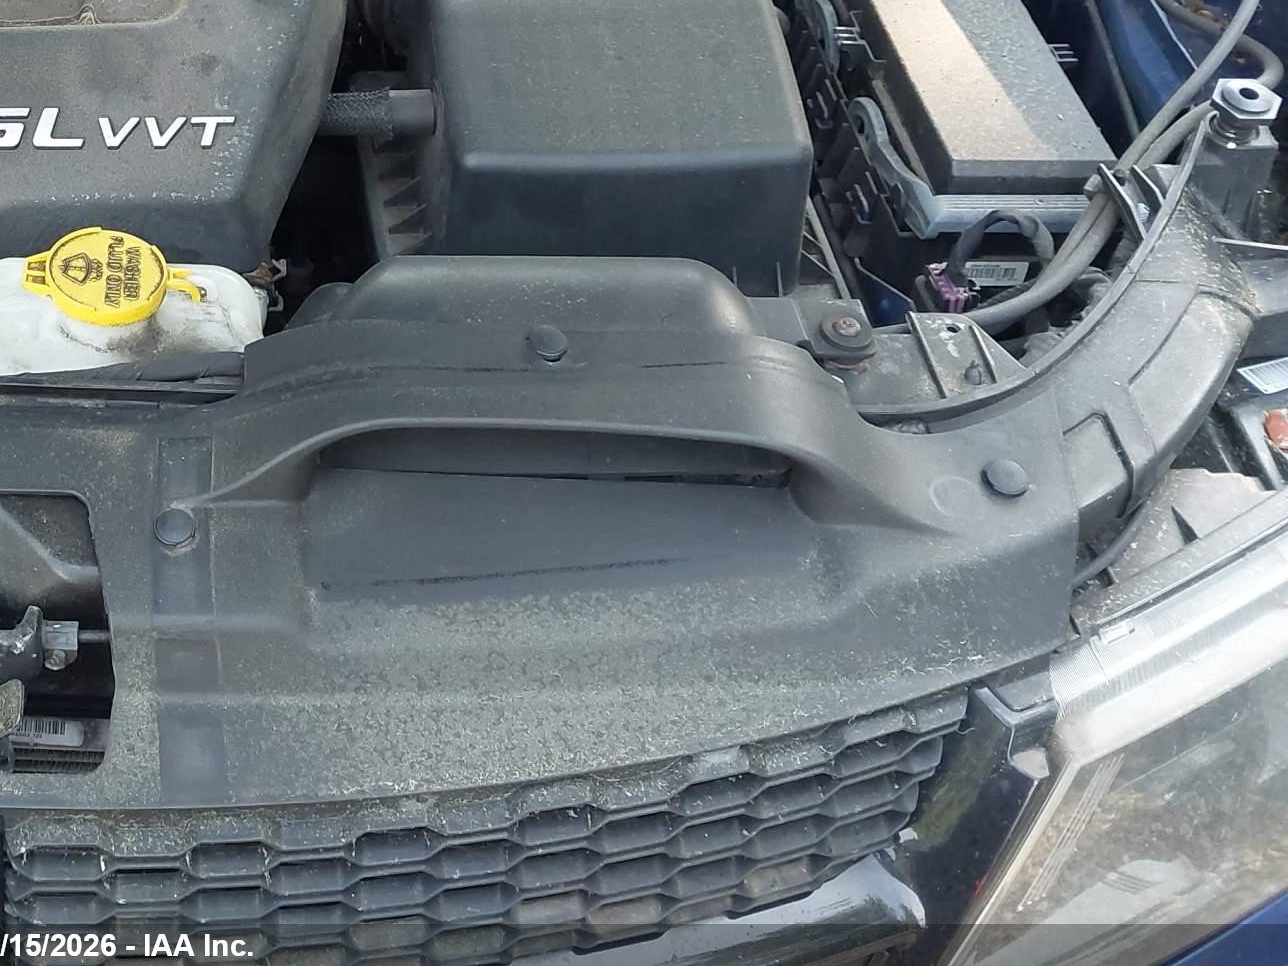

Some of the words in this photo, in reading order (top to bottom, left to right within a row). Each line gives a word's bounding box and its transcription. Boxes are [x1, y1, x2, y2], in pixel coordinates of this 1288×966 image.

[98, 116, 236, 149] VVT
[107, 236, 125, 273] FLUID
[104, 274, 123, 309] ONLY
[123, 246, 142, 301] WASHER
